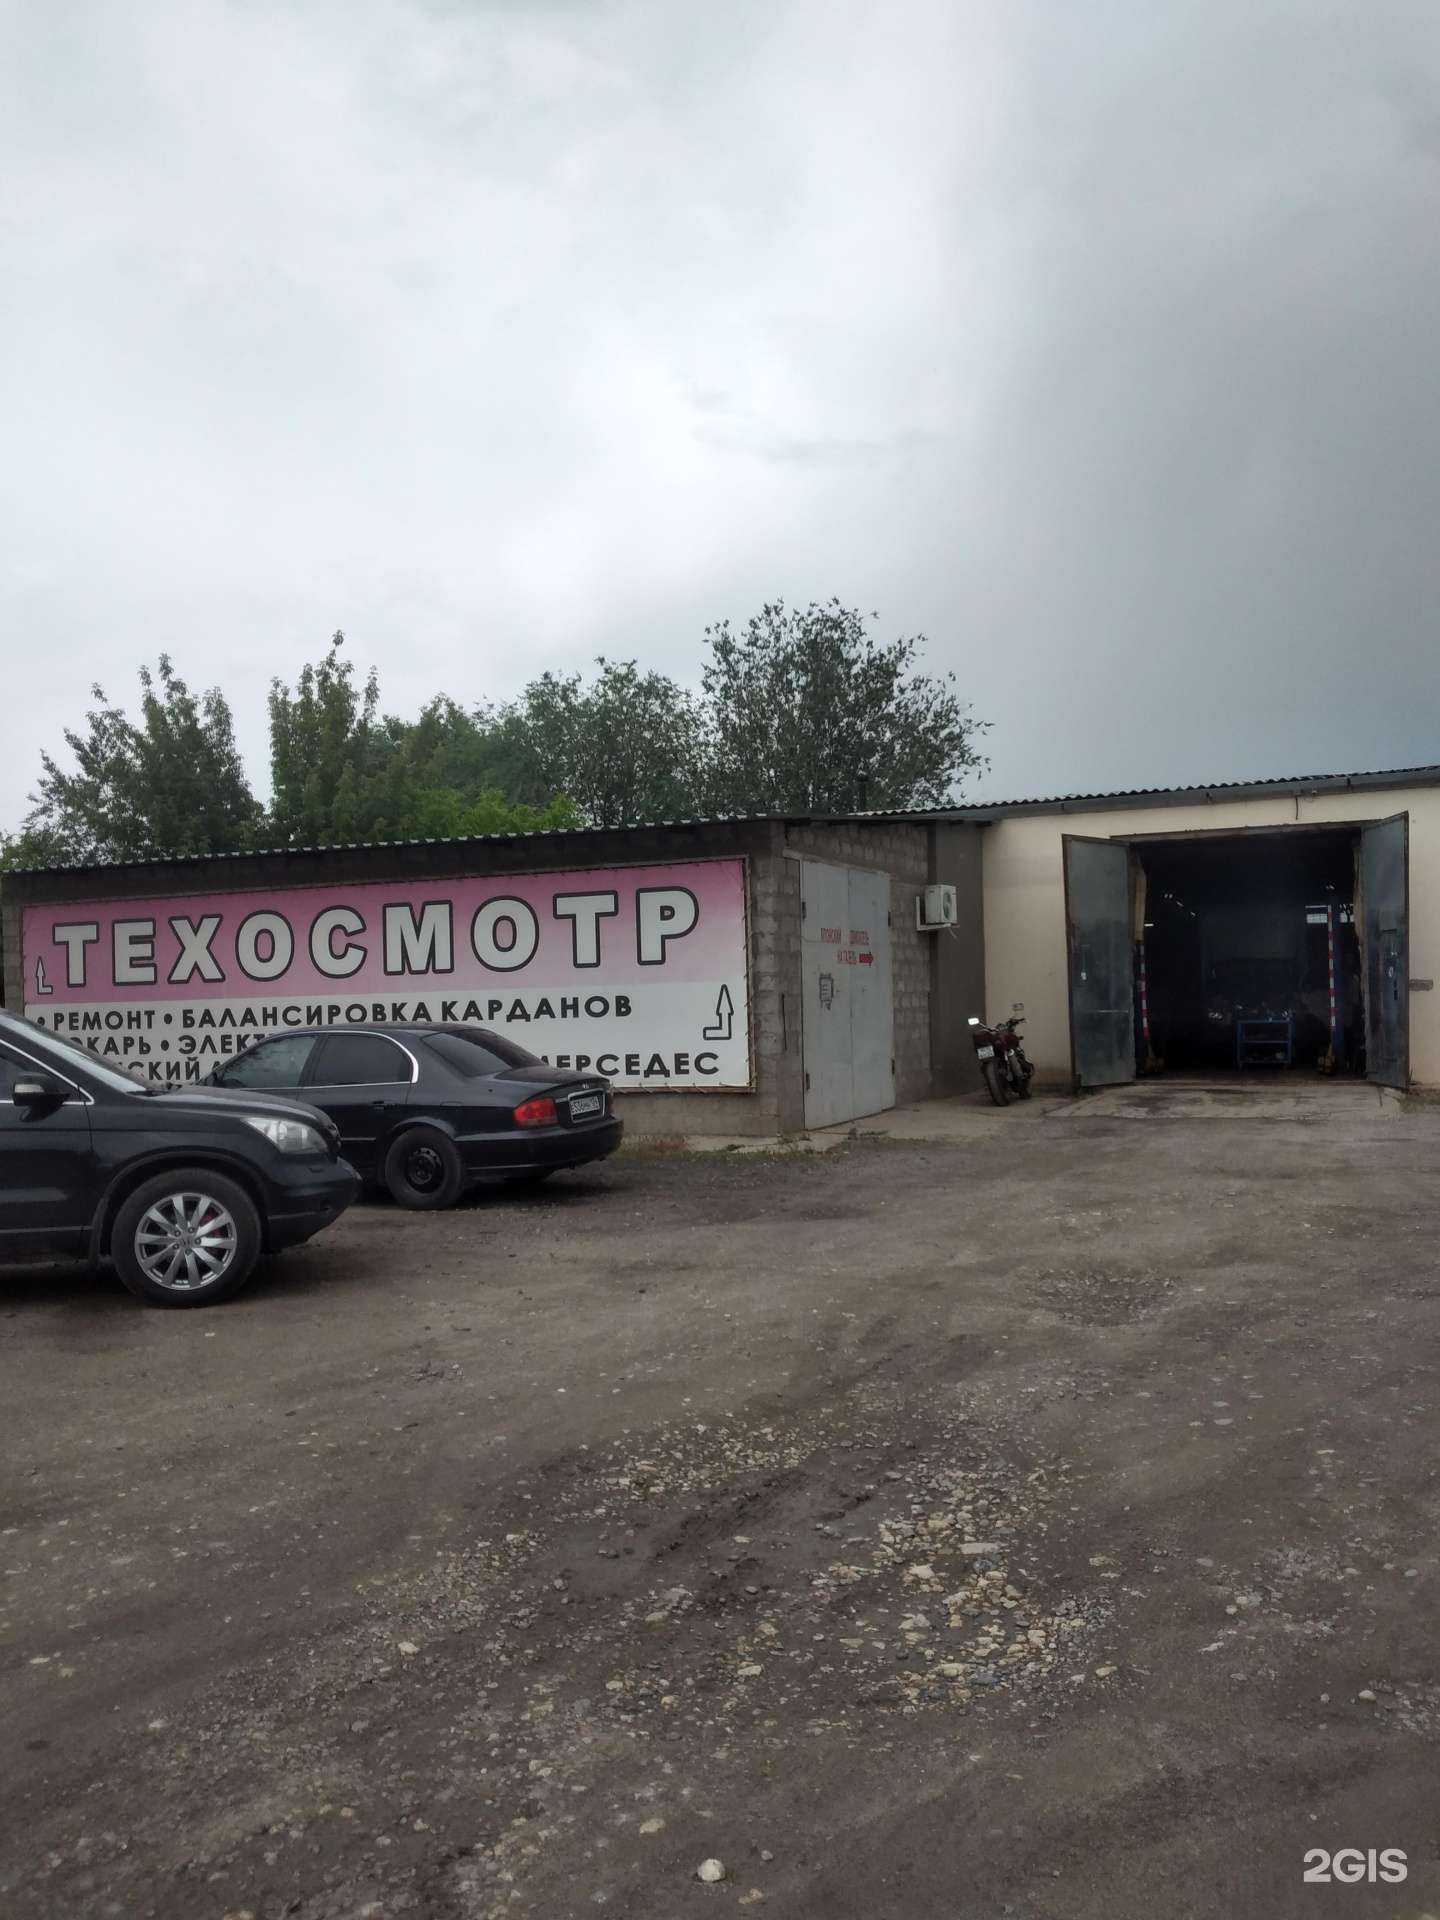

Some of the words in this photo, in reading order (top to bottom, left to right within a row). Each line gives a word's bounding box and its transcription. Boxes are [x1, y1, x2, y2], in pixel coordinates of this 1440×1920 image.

[52, 886, 699, 987] ТЕХОСМОТР
[54, 1010, 155, 1031] РЕМОНТ
[182, 1001, 432, 1029] БАЛАНСИРОВКА
[441, 996, 632, 1023] КАРДАНОВ
